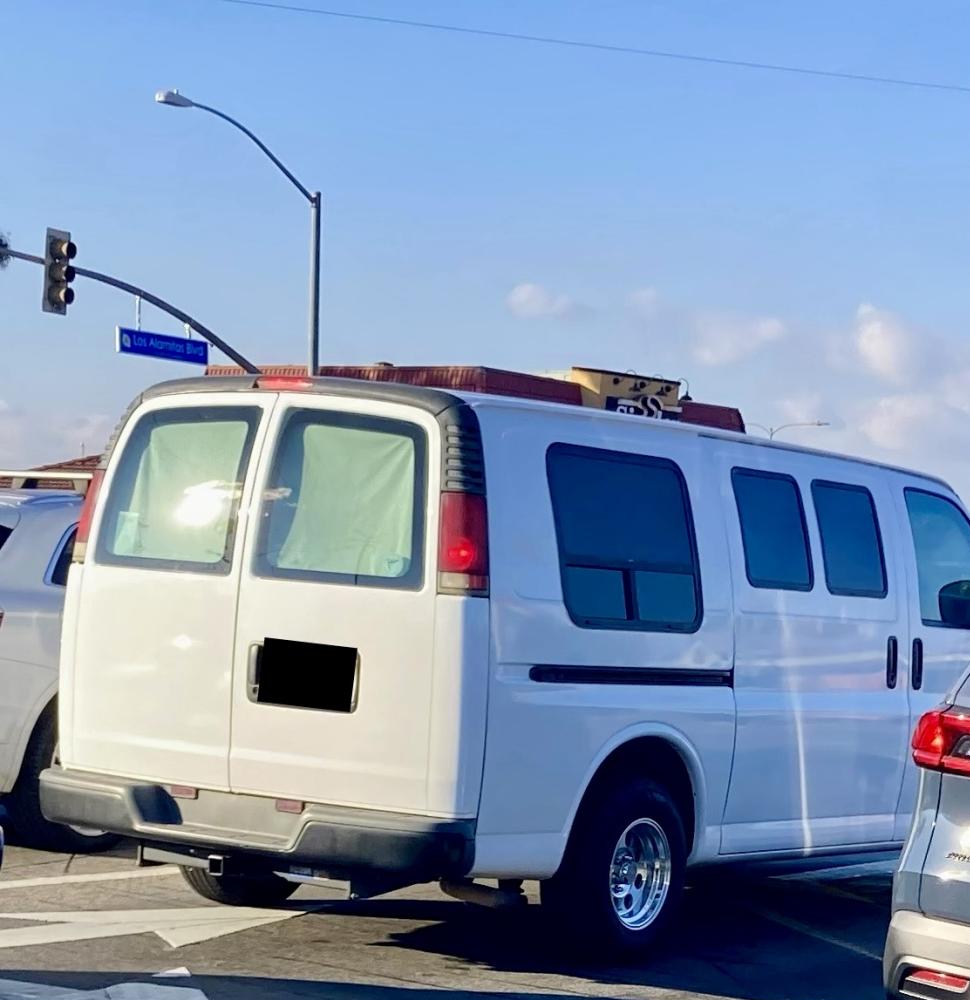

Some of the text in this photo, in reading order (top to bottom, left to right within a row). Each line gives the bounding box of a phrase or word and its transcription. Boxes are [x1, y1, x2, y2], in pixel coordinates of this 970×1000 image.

[132, 334, 204, 357] Los Alamitos Blvd
